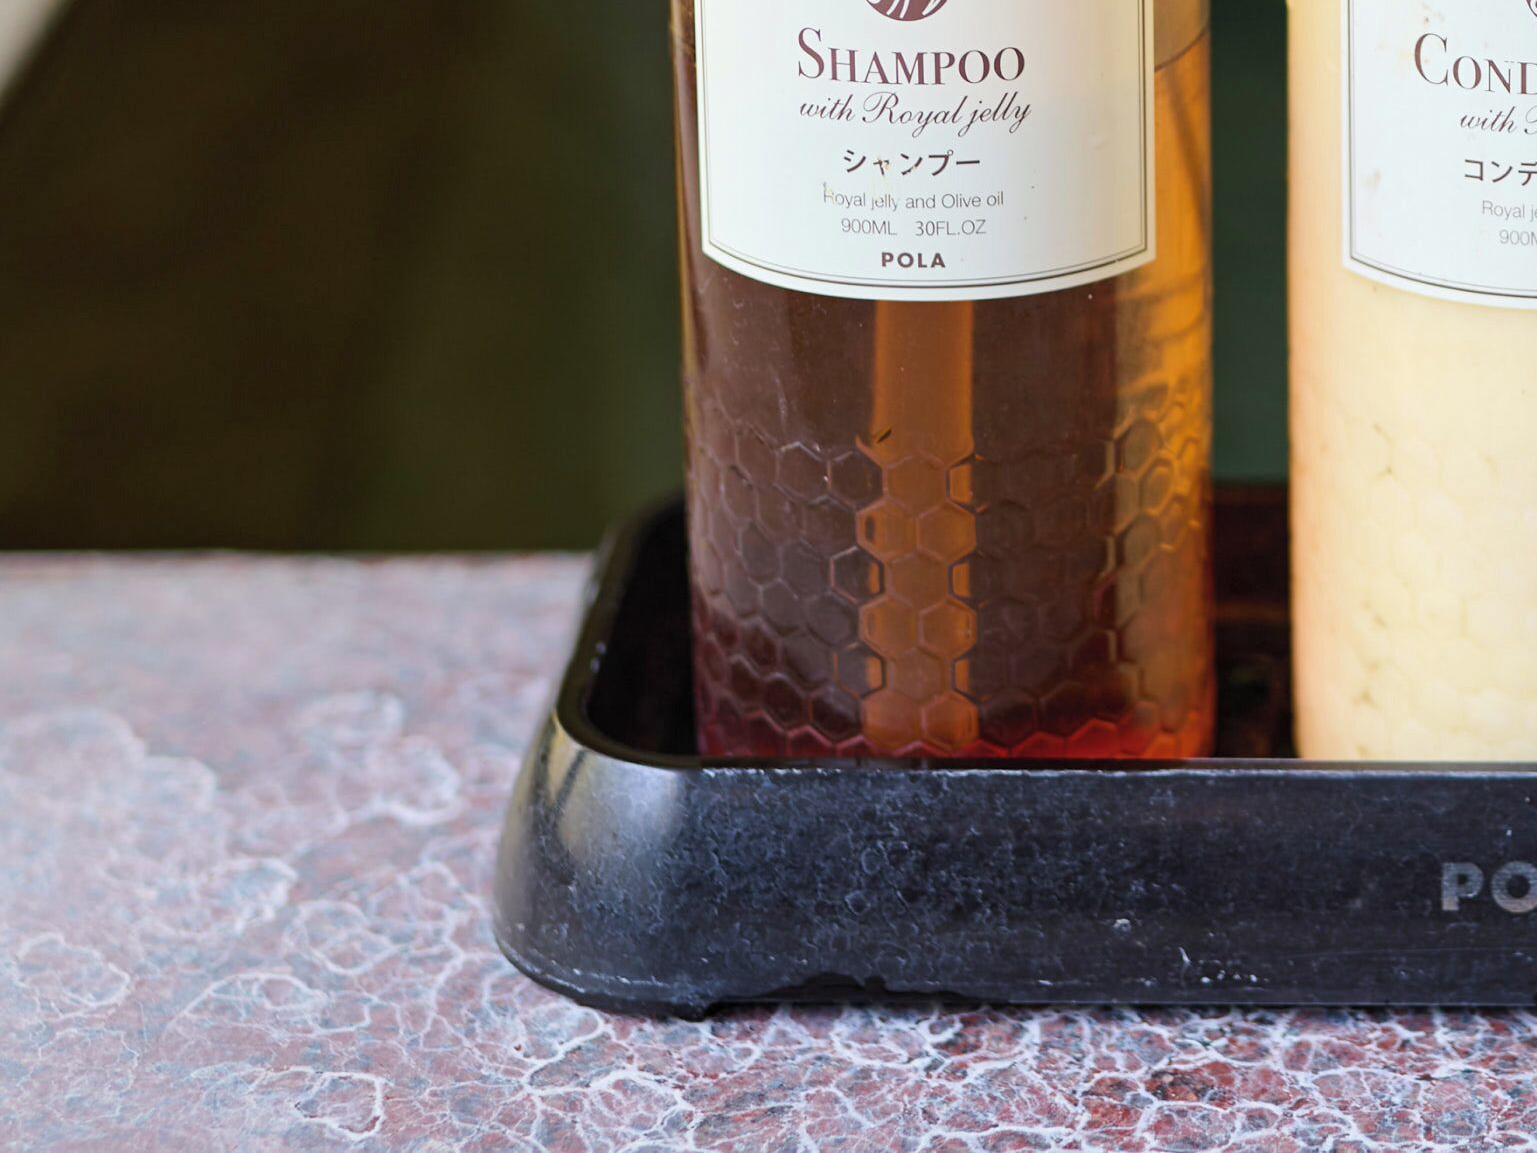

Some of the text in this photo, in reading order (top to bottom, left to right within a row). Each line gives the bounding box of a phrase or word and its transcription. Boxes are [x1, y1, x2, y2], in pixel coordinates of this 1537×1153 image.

[800, 91, 1032, 137] with Royal jelly
[1460, 108, 1516, 134] with
[842, 149, 980, 177] シャンプー
[871, 192, 900, 212] jelly
[905, 193, 936, 209] and
[941, 192, 982, 209] Olive
[986, 192, 1004, 207] oil
[1482, 200, 1525, 219] Royal
[841, 219, 987, 237] 900ML 30FL.OZ
[881, 252, 946, 268] POLA
